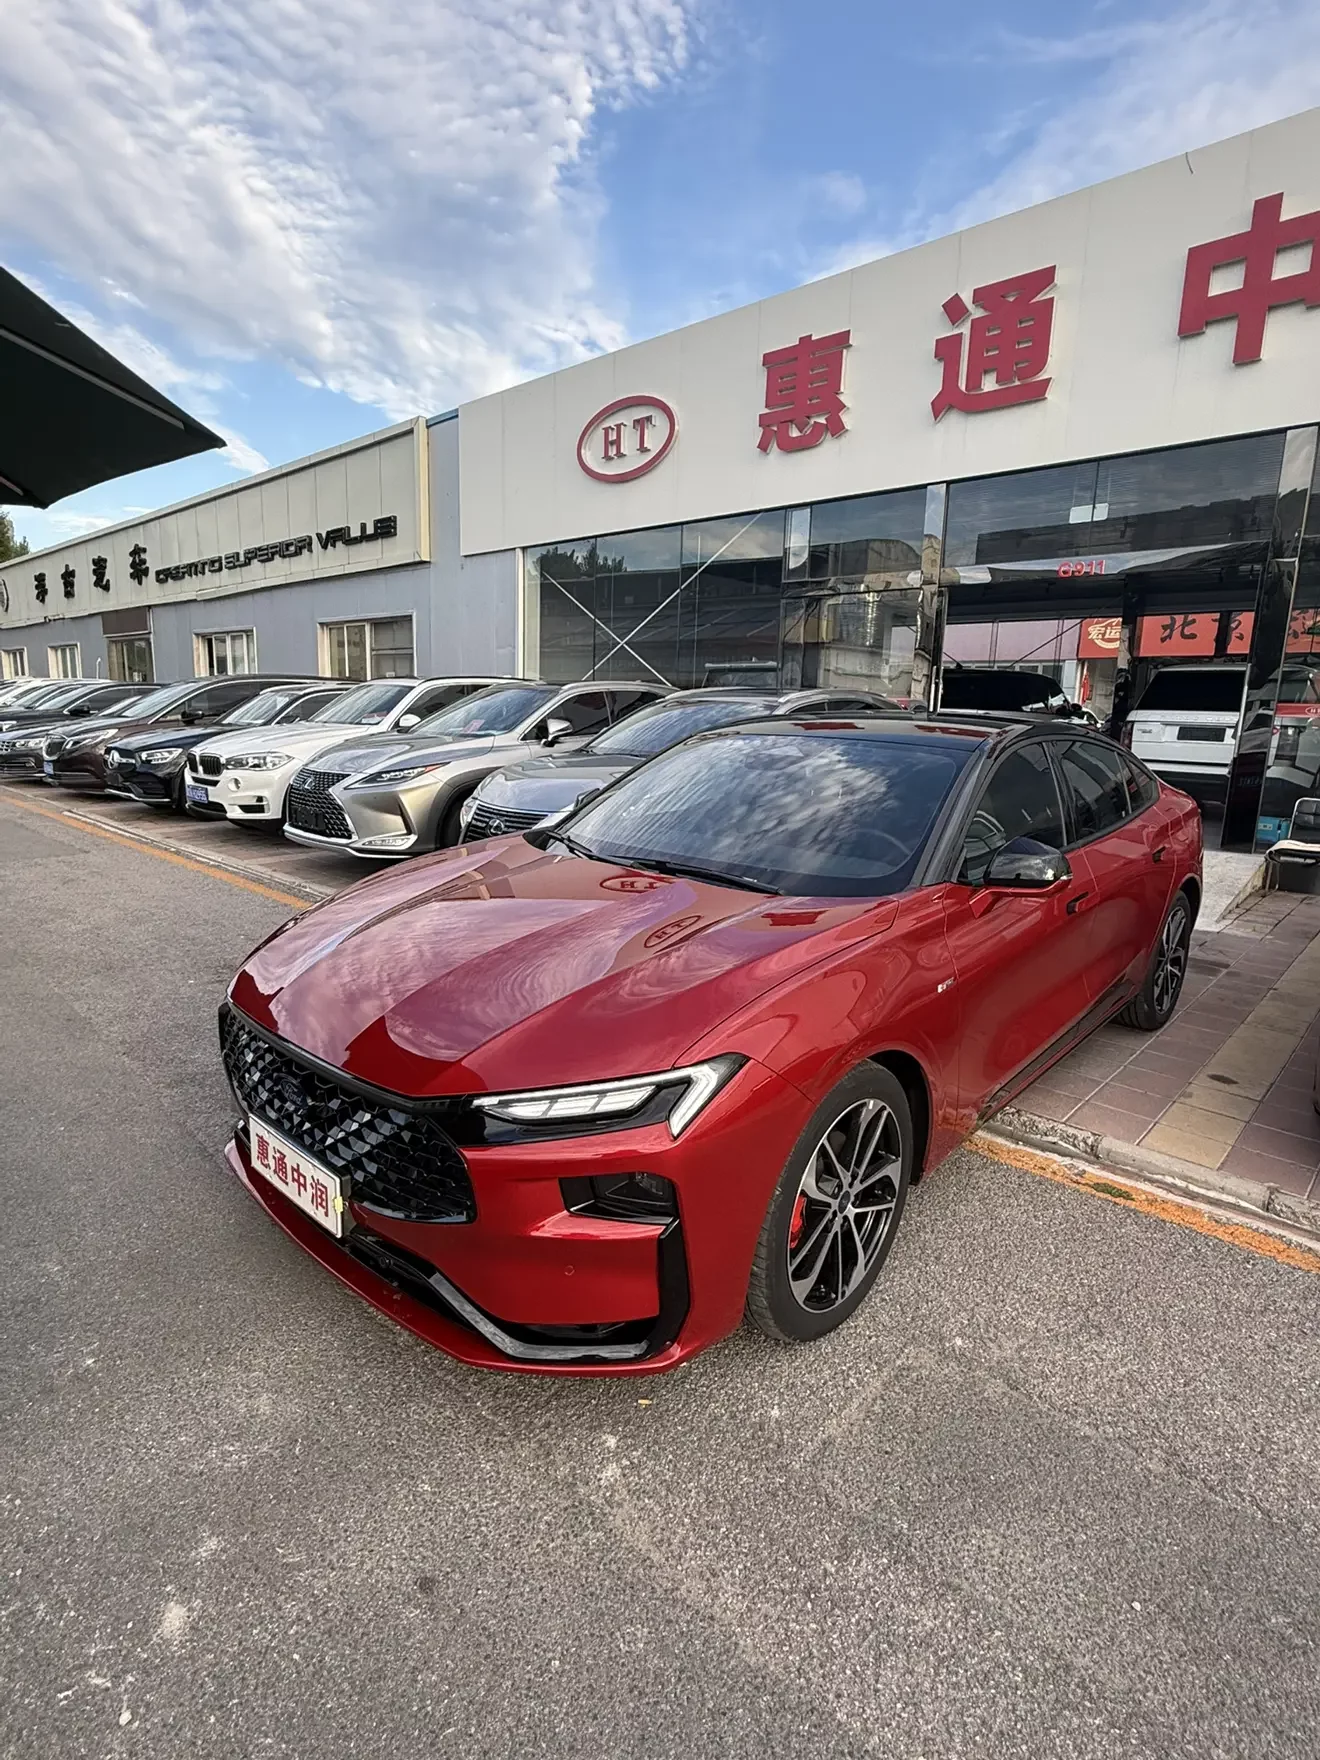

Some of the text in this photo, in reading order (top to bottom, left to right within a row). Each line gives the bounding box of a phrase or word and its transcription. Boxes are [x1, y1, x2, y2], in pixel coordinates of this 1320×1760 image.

[757, 192, 1320, 454] 惠通中
[601, 414, 656, 461] HT
[256, 1132, 329, 1218] 惠通中润
